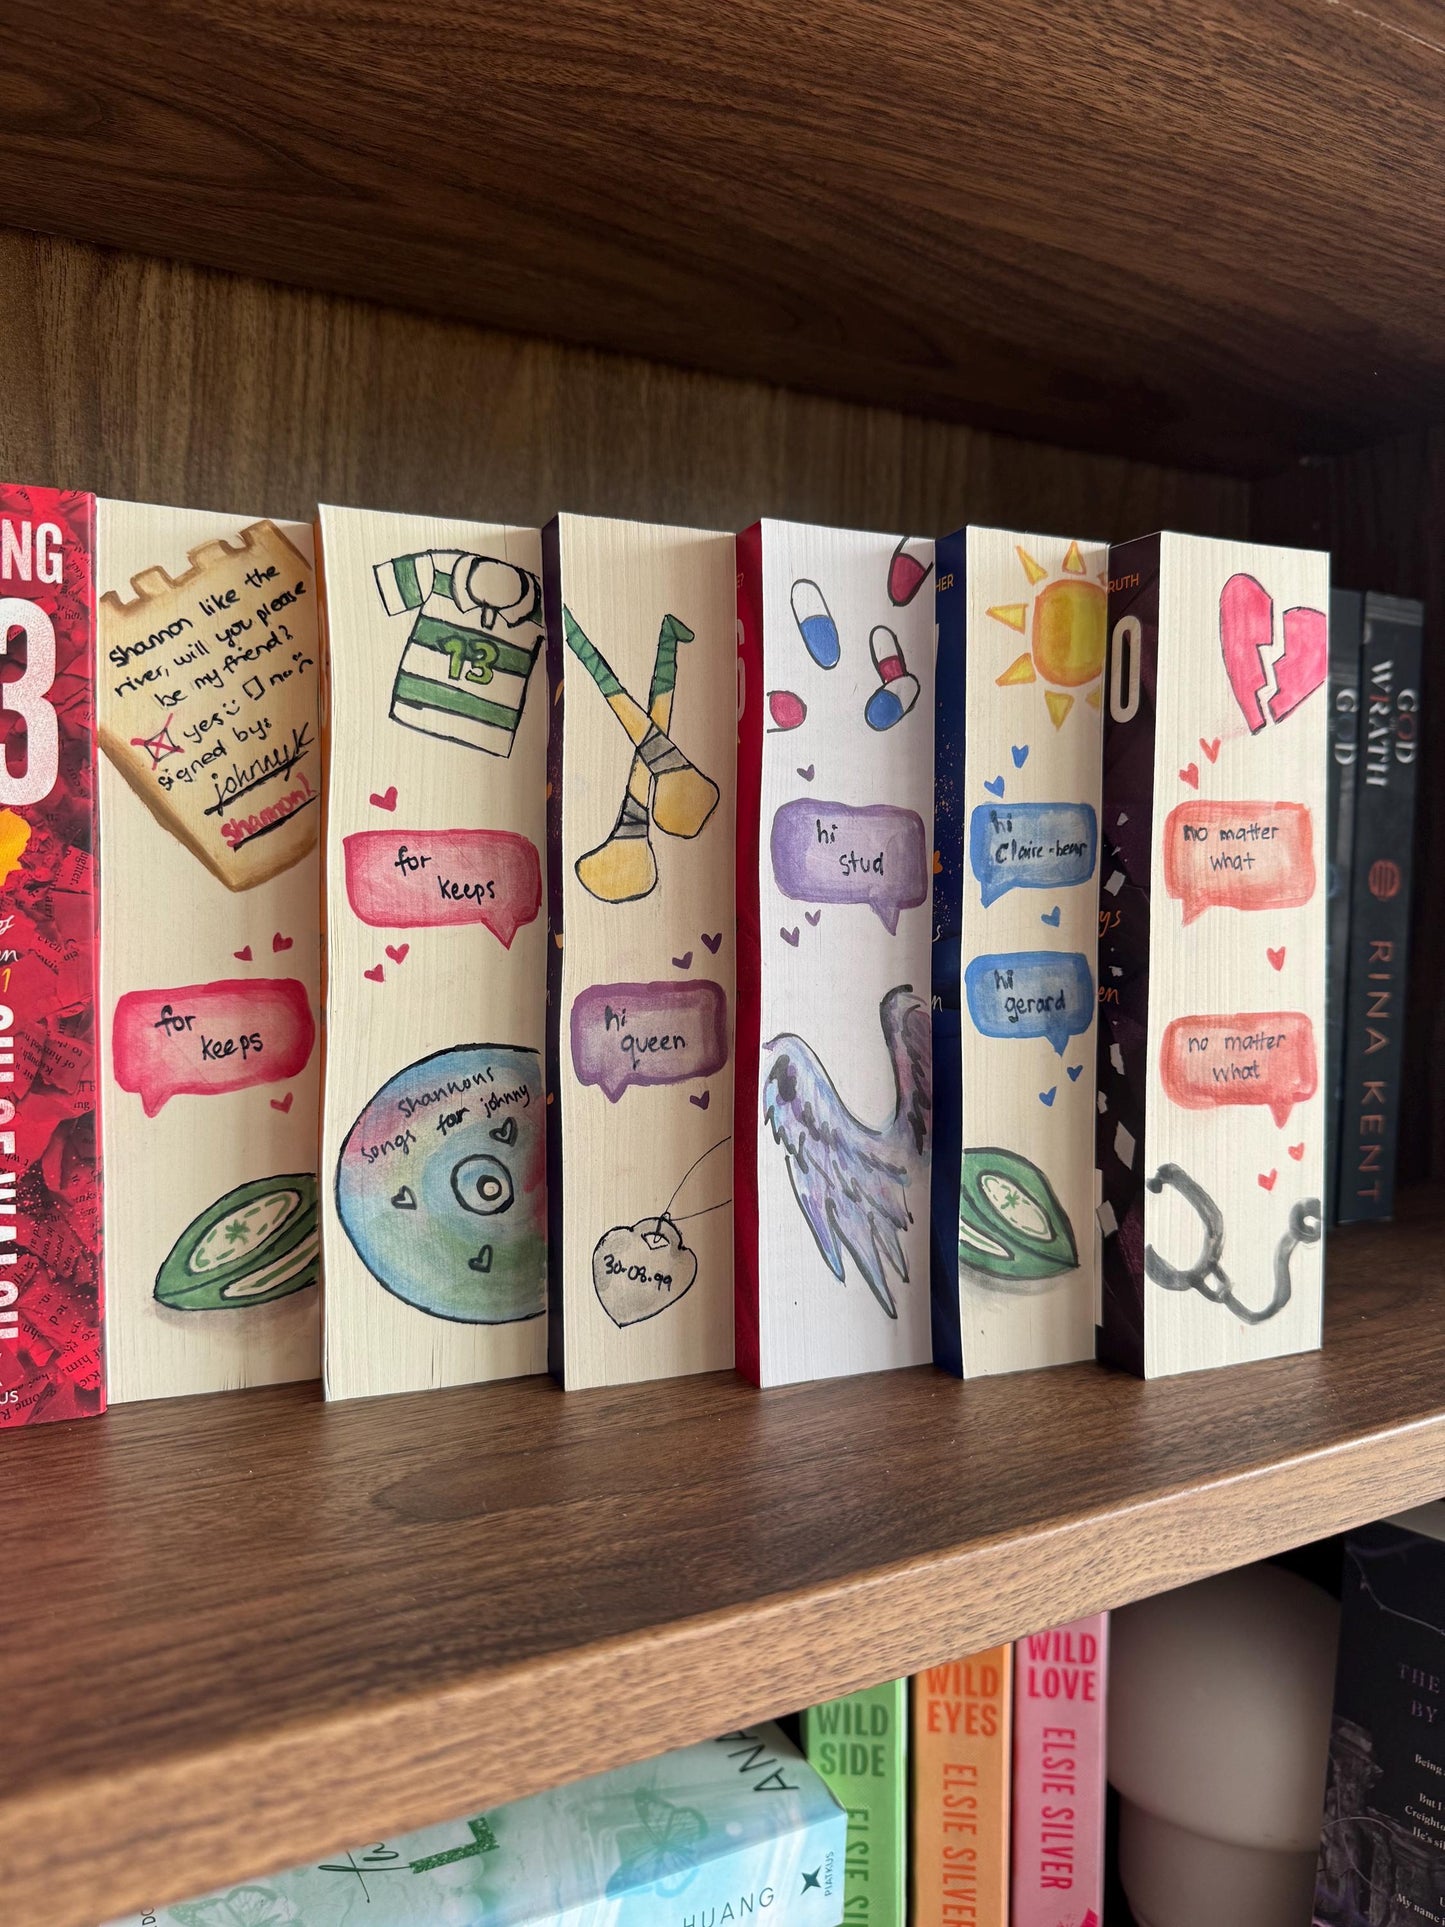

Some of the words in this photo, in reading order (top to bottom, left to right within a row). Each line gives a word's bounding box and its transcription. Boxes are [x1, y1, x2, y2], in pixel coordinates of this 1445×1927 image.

[1, 519, 63, 584] NG
[199, 589, 240, 616] like
[244, 566, 280, 588] the
[114, 666, 169, 697] river,
[174, 640, 210, 666] will
[216, 618, 252, 648] you
[257, 581, 306, 626] please
[155, 690, 188, 707] be
[194, 669, 224, 688] my
[223, 625, 293, 674] friend?
[442, 636, 498, 685] 13
[1335, 688, 1359, 765] GOD
[1395, 688, 1418, 764] GOD
[158, 739, 228, 791] signed
[816, 819, 838, 844] hi
[990, 810, 1013, 834] hi
[1183, 824, 1208, 842] no
[1220, 823, 1280, 842] matter
[394, 845, 432, 876] for
[839, 850, 884, 876] stud
[1210, 852, 1256, 871] what
[437, 875, 496, 906] keeps
[994, 969, 1014, 990] hi
[1004, 990, 1066, 1023] gerard
[1364, 940, 1393, 1055] RINA
[154, 1004, 196, 1037] for
[604, 1005, 626, 1031] hi
[200, 1032, 264, 1061] keeps
[621, 1034, 686, 1071] queen
[1188, 1035, 1208, 1052] no
[1224, 1032, 1286, 1051] matter
[1212, 1061, 1260, 1082] what
[436, 1107, 470, 1136] for
[480, 1084, 530, 1118] johnny
[1357, 1080, 1387, 1202] KENT
[1027, 1630, 1098, 1664] WILD
[925, 1664, 999, 1699] WILD
[1027, 1667, 1096, 1701] LOVE
[1400, 1664, 1440, 1693] THE
[816, 1702, 889, 1737] WILD
[927, 1700, 997, 1738] EYES
[1411, 1700, 1438, 1723] BY
[819, 1742, 886, 1777] SIDE
[1042, 1727, 1076, 1796] ELSIE
[1415, 1754, 1442, 1776] Being
[943, 1762, 977, 1836] ELSIE
[1040, 1805, 1074, 1890] SILVER
[824, 1851, 835, 1897] PIATKUS
[683, 1887, 774, 1927] HUANG
